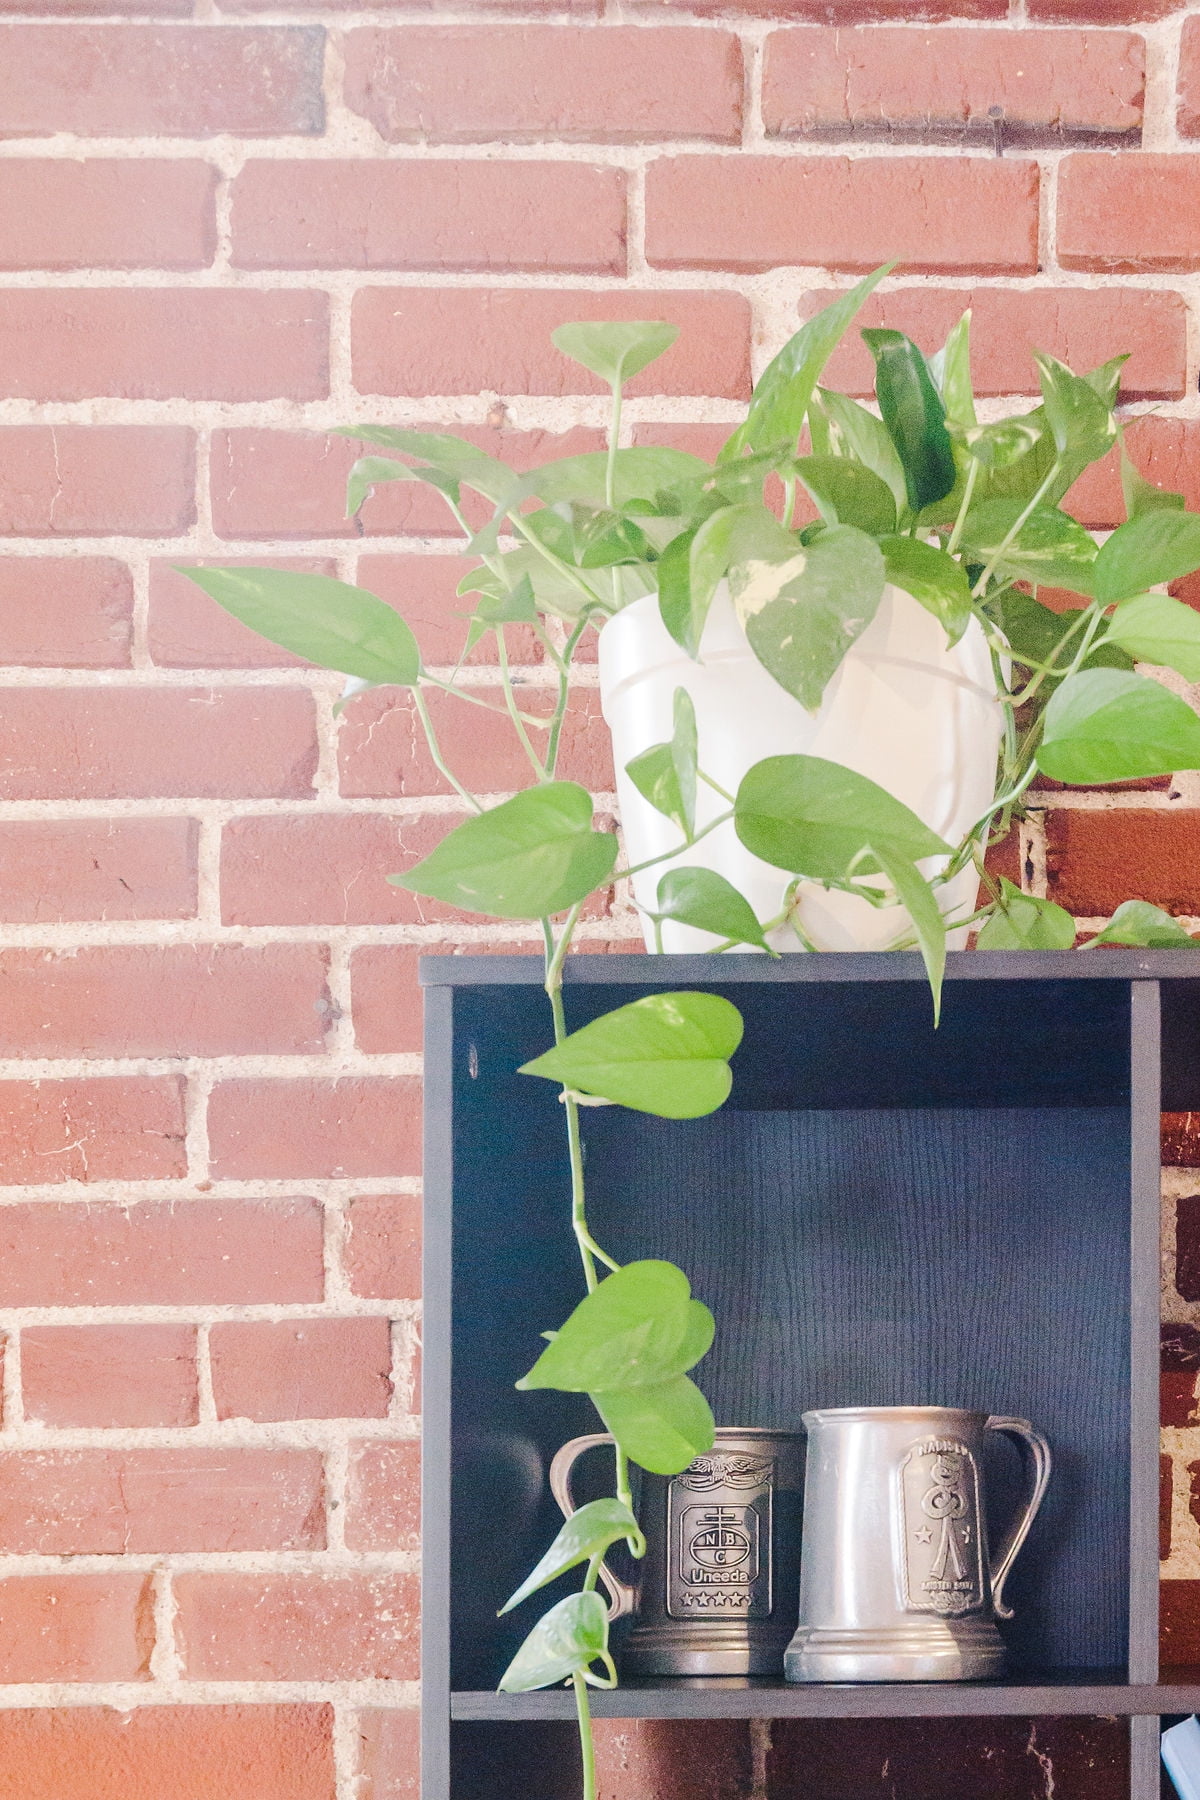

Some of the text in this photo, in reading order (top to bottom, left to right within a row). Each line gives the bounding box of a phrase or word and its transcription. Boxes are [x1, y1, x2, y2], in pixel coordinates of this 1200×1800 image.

[706, 1533, 736, 1545] N B
[715, 1550, 726, 1563] C
[691, 1568, 749, 1583] Uneeda
